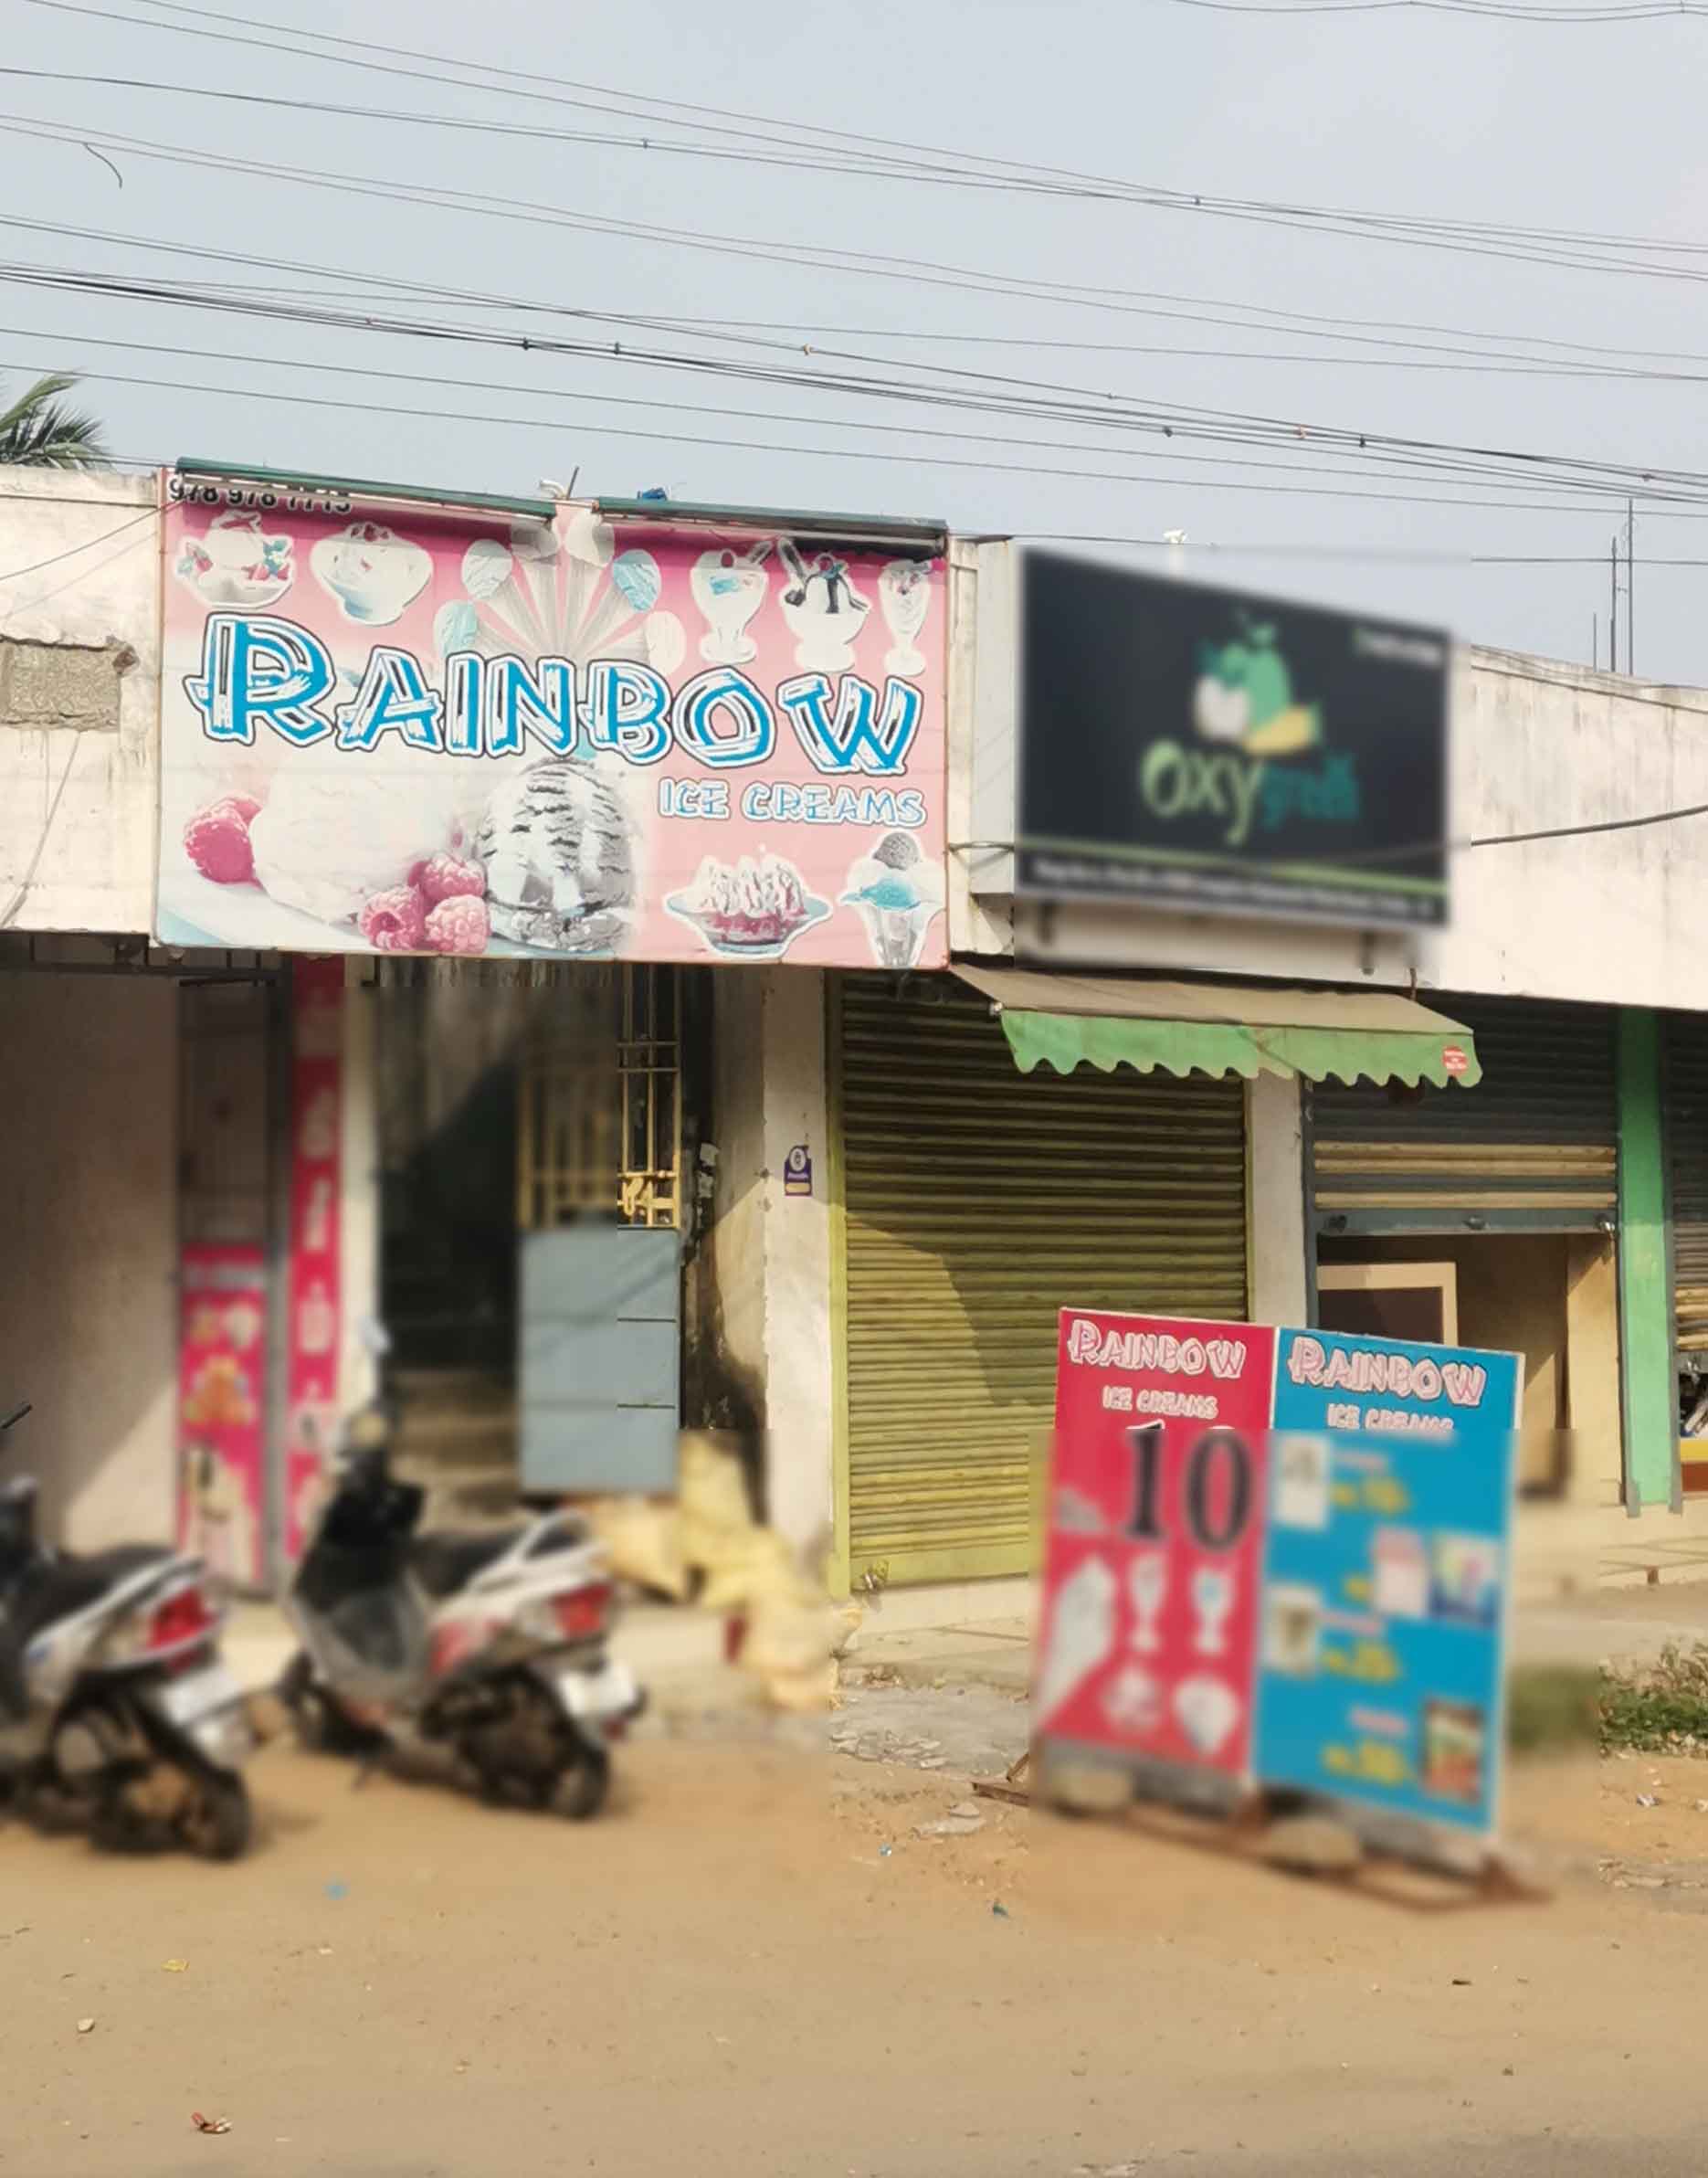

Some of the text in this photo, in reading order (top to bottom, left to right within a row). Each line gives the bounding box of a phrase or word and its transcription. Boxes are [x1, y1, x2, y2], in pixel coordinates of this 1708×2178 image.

[184, 611, 923, 777] RAINBOW
[658, 776, 928, 829] ICE CREAMS
[1067, 1318, 1248, 1380] RAINBOW
[1287, 1336, 1488, 1407] RAINBOW
[1102, 1385, 1219, 1420] ICE CREAMS
[1327, 1402, 1361, 1431] ICE
[1123, 1419, 1255, 1554] 10
